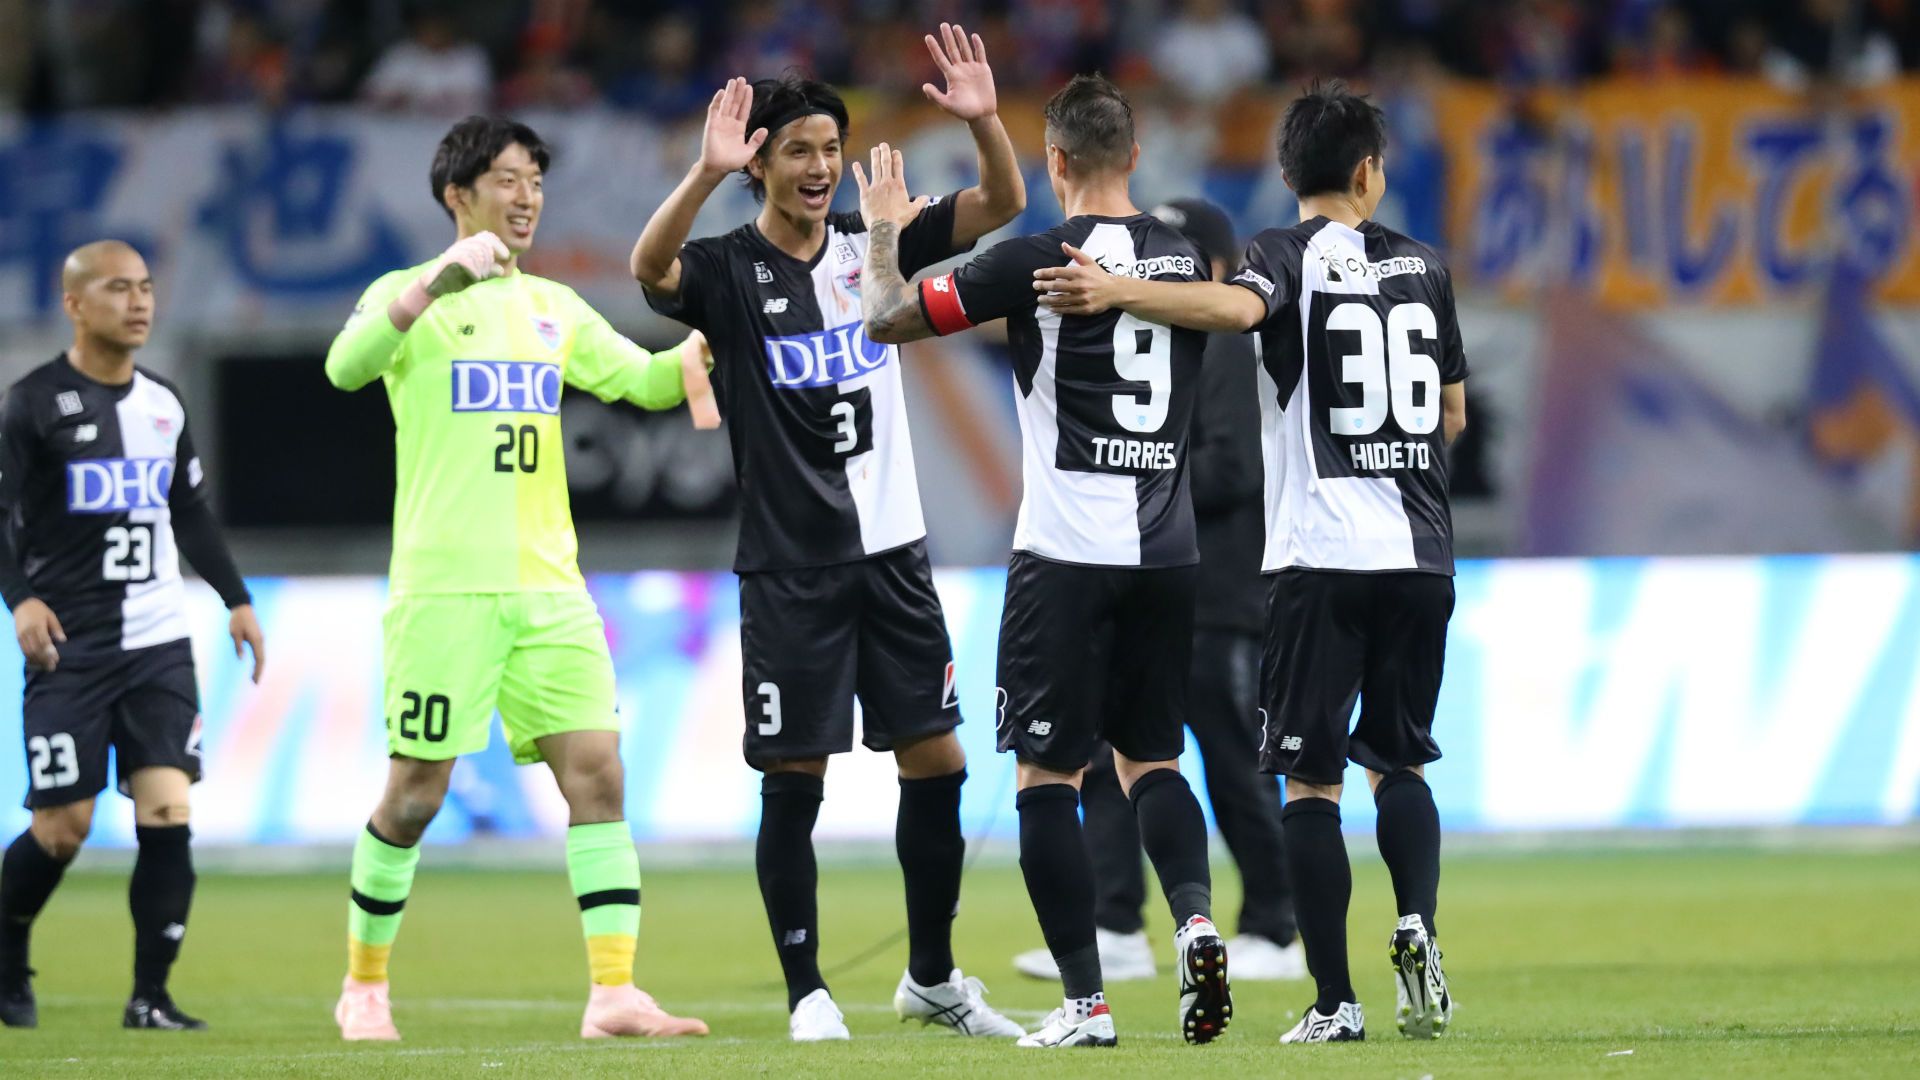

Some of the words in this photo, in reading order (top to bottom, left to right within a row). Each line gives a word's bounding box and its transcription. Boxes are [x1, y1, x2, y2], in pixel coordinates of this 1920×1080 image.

[766, 322, 888, 384] DHC
[1111, 310, 1172, 433] 9
[1325, 302, 1441, 435] 36
[494, 423, 539, 473] 20
[830, 401, 858, 454] 3
[1091, 436, 1177, 470] TORRES
[1350, 442, 1430, 470] HIDETO
[103, 526, 151, 580] 23
[400, 691, 450, 742] 20
[757, 681, 783, 736] 3
[29, 732, 80, 790] 23
